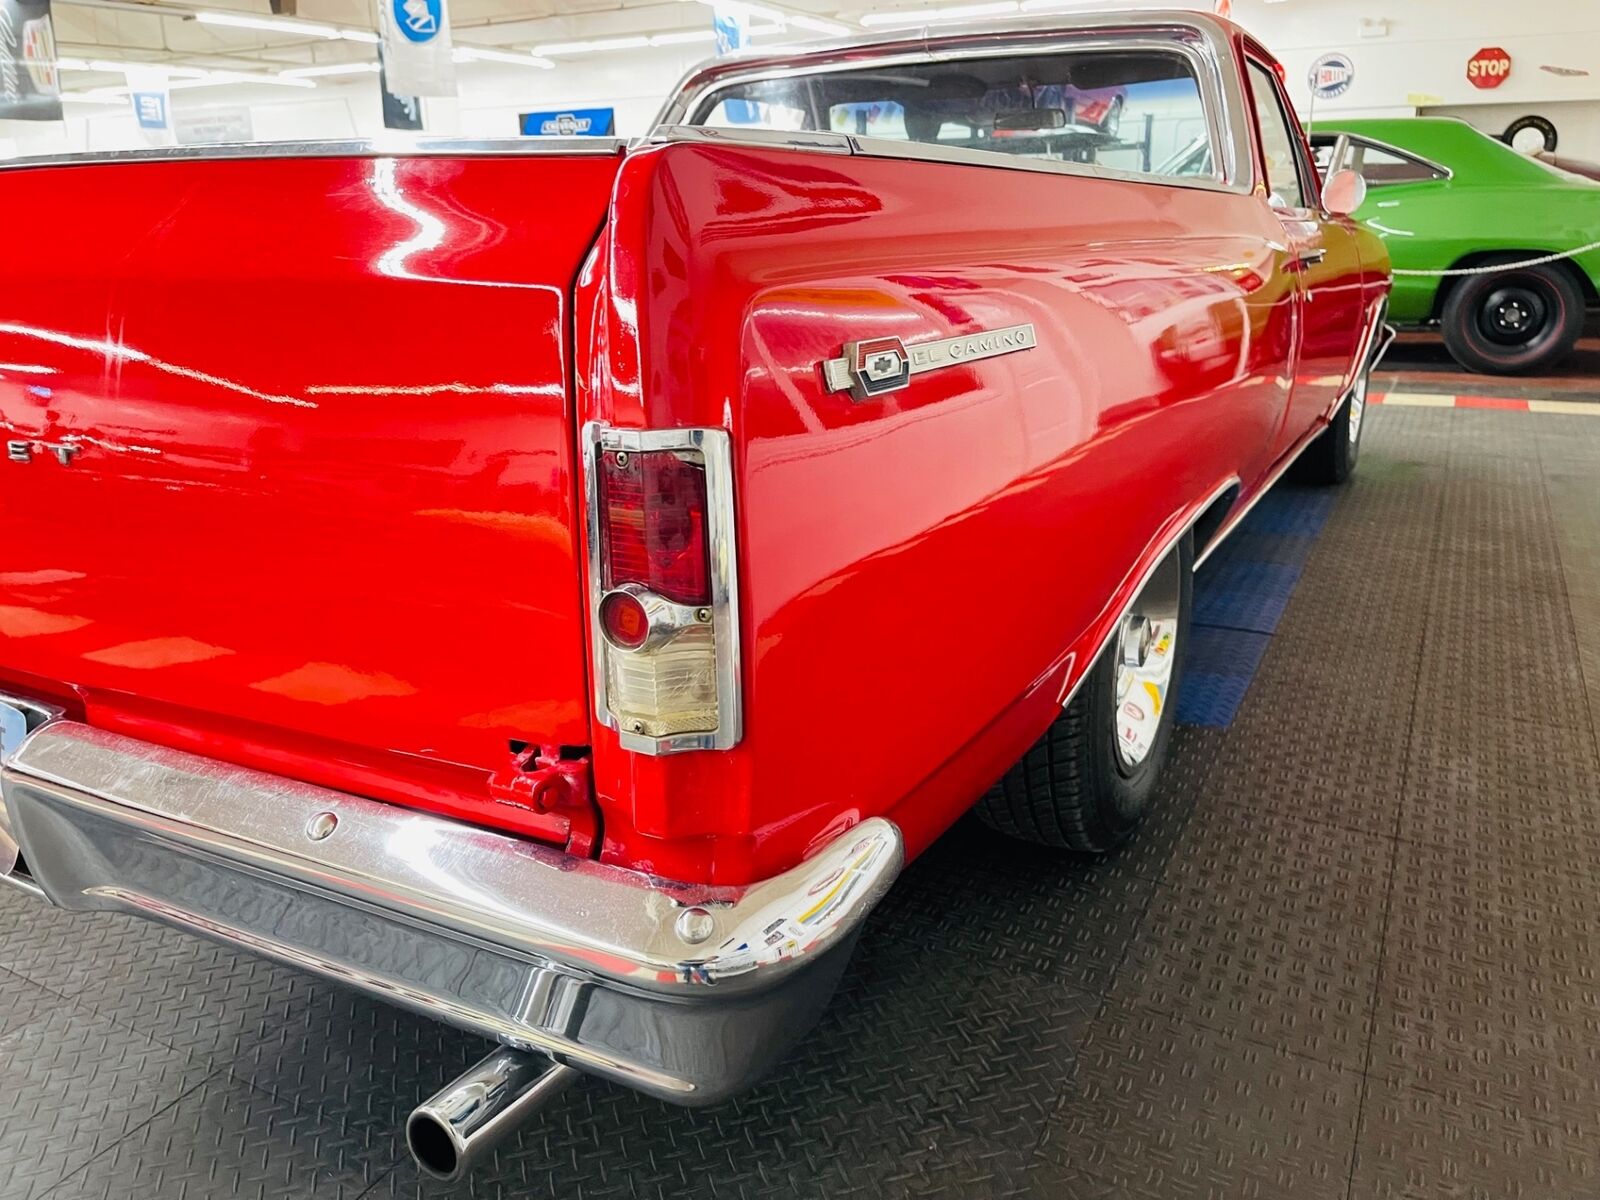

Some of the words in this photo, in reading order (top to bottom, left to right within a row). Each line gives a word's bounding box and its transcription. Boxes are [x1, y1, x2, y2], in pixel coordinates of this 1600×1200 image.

[1469, 59, 1509, 77] STOP
[912, 350, 941, 366] EL
[948, 330, 1026, 359] CAMINO
